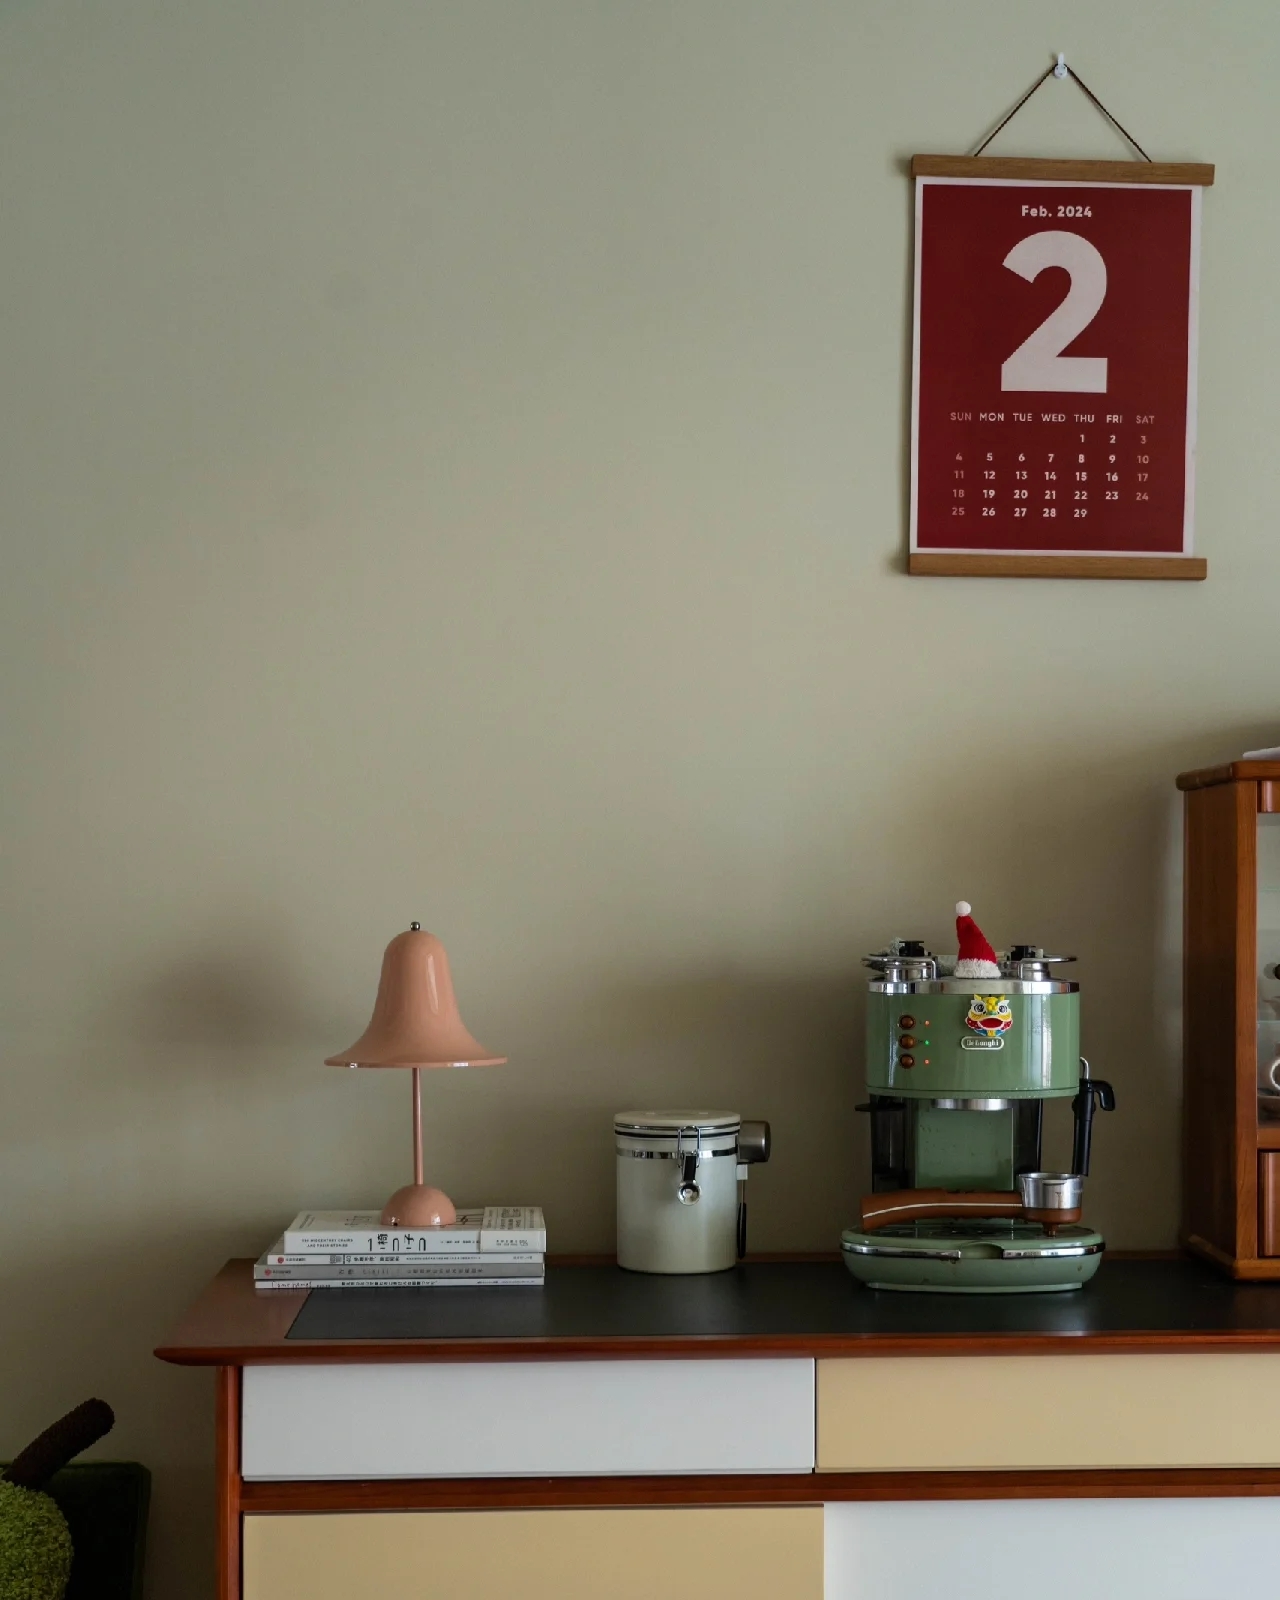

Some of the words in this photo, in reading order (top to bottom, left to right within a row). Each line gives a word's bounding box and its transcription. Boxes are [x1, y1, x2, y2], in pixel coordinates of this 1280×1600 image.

[1021, 205, 1052, 217] Feb.
[1057, 205, 1092, 218] 2024
[1001, 230, 1108, 393] 2
[950, 412, 971, 421] SUN
[980, 413, 1004, 422] MON
[1013, 413, 1033, 422] TUE
[1041, 413, 1066, 423] WED
[1074, 414, 1095, 423] THU
[1106, 415, 1123, 424] FRI
[1135, 415, 1155, 425] SAT
[1079, 434, 1085, 443] 1
[1109, 435, 1116, 444] 2
[1140, 435, 1147, 445] 3
[955, 452, 963, 461] 4
[986, 453, 994, 462] 5
[1018, 453, 1026, 462] 6
[1048, 454, 1055, 463] 7
[1078, 454, 1085, 464] 8
[1108, 454, 1116, 464] 9
[1136, 455, 1149, 464] 10
[954, 470, 964, 479] 11
[983, 471, 996, 480] 12
[1015, 471, 1028, 480] 13
[1044, 472, 1057, 481] 14
[1075, 472, 1088, 482] 15
[1106, 472, 1118, 482] 16
[1137, 473, 1149, 482] 17
[952, 489, 965, 498] 18
[982, 489, 996, 499] 19
[1013, 490, 1028, 499] 20
[1044, 490, 1056, 500] 21
[1074, 491, 1088, 500] 22
[1105, 491, 1119, 500] 23
[1136, 492, 1149, 501] 24
[951, 507, 965, 516] 25
[982, 507, 996, 517] 26
[1014, 508, 1027, 517] 27
[1042, 508, 1057, 517] 28
[1073, 509, 1088, 518] 29
